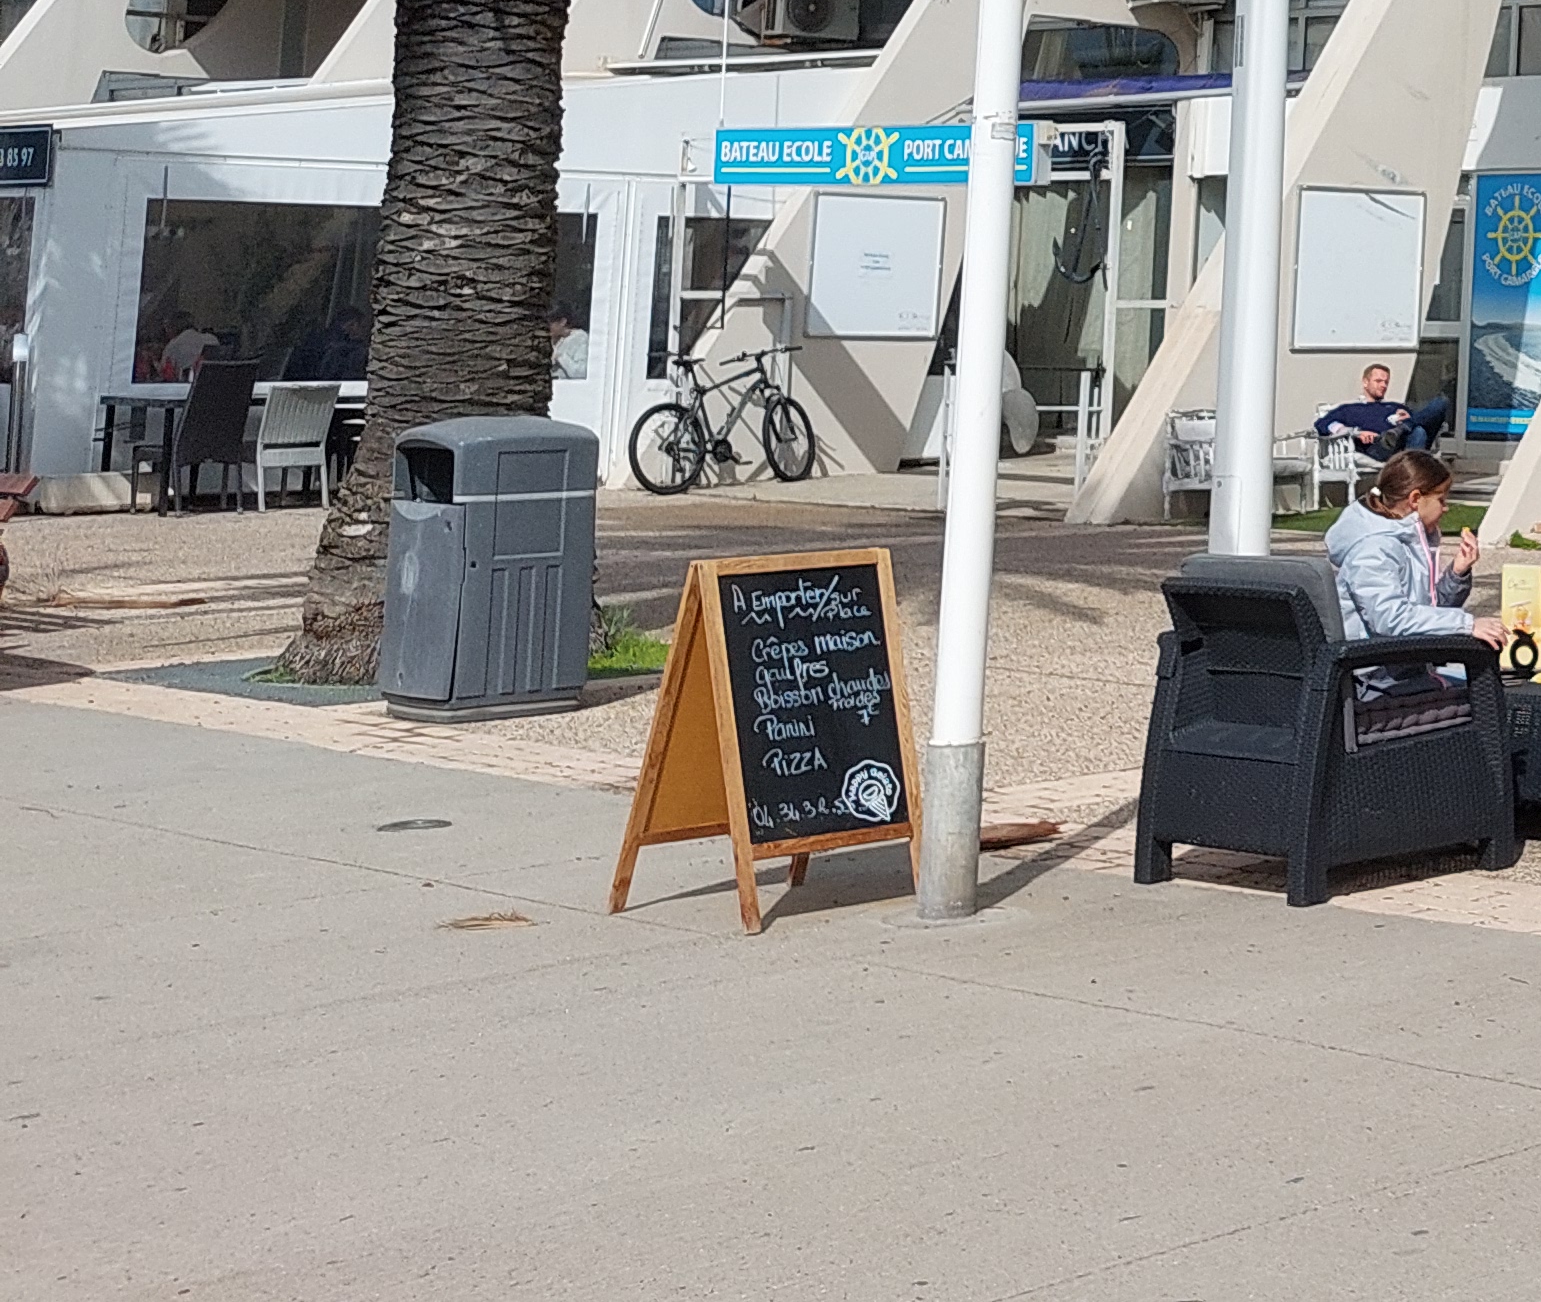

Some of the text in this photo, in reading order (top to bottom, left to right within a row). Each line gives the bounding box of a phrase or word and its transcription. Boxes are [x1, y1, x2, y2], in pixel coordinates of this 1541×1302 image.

[7, 147, 19, 167] 85
[21, 147, 35, 167] 97
[721, 140, 780, 163] BATEAU
[782, 140, 833, 163] ECOLE
[903, 139, 943, 162] PORT
[731, 584, 747, 613] A
